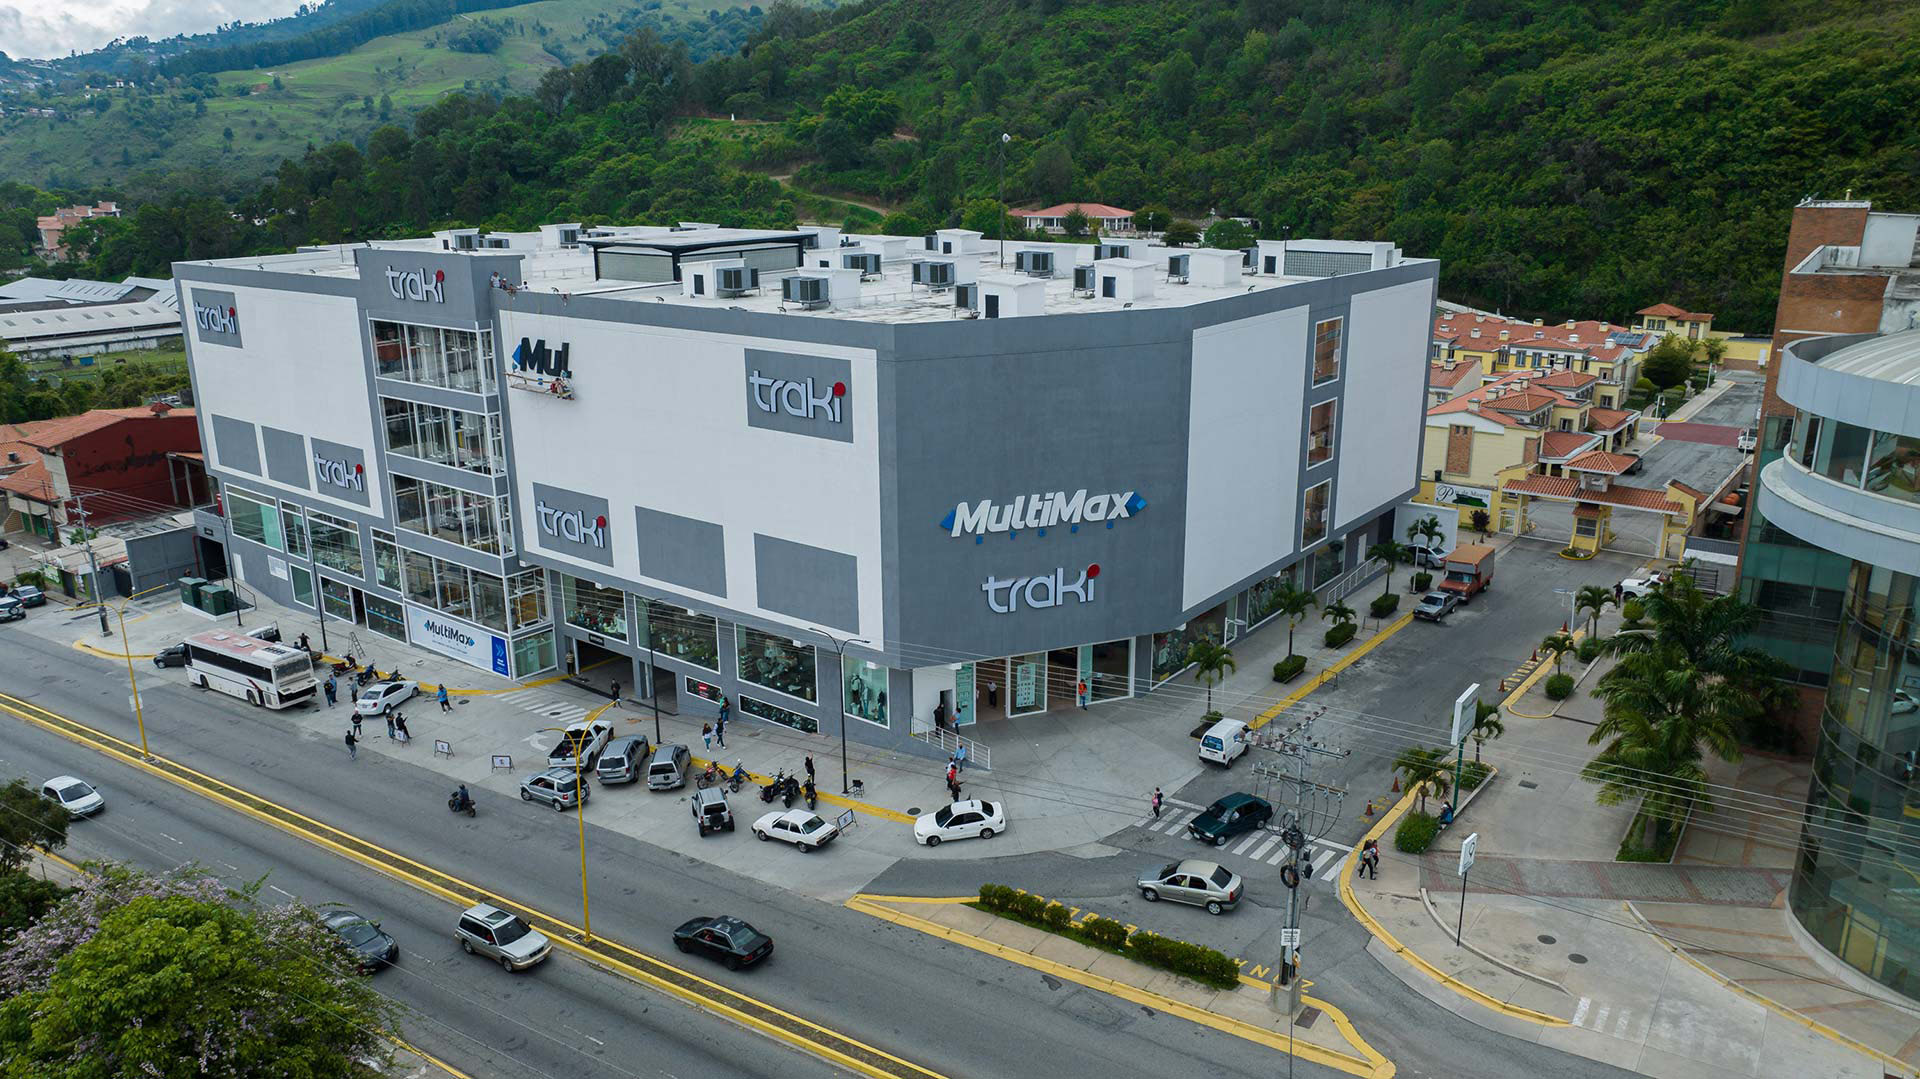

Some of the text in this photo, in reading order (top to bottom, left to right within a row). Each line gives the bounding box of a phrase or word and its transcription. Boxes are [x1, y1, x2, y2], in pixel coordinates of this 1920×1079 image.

[385, 265, 444, 303] traki
[194, 302, 236, 334] traki
[749, 370, 846, 422] traki
[314, 453, 363, 491] traki
[537, 501, 606, 548] traki
[951, 489, 1135, 538] MultiMax
[982, 564, 1100, 613] traki
[426, 620, 471, 646] MultiMax
